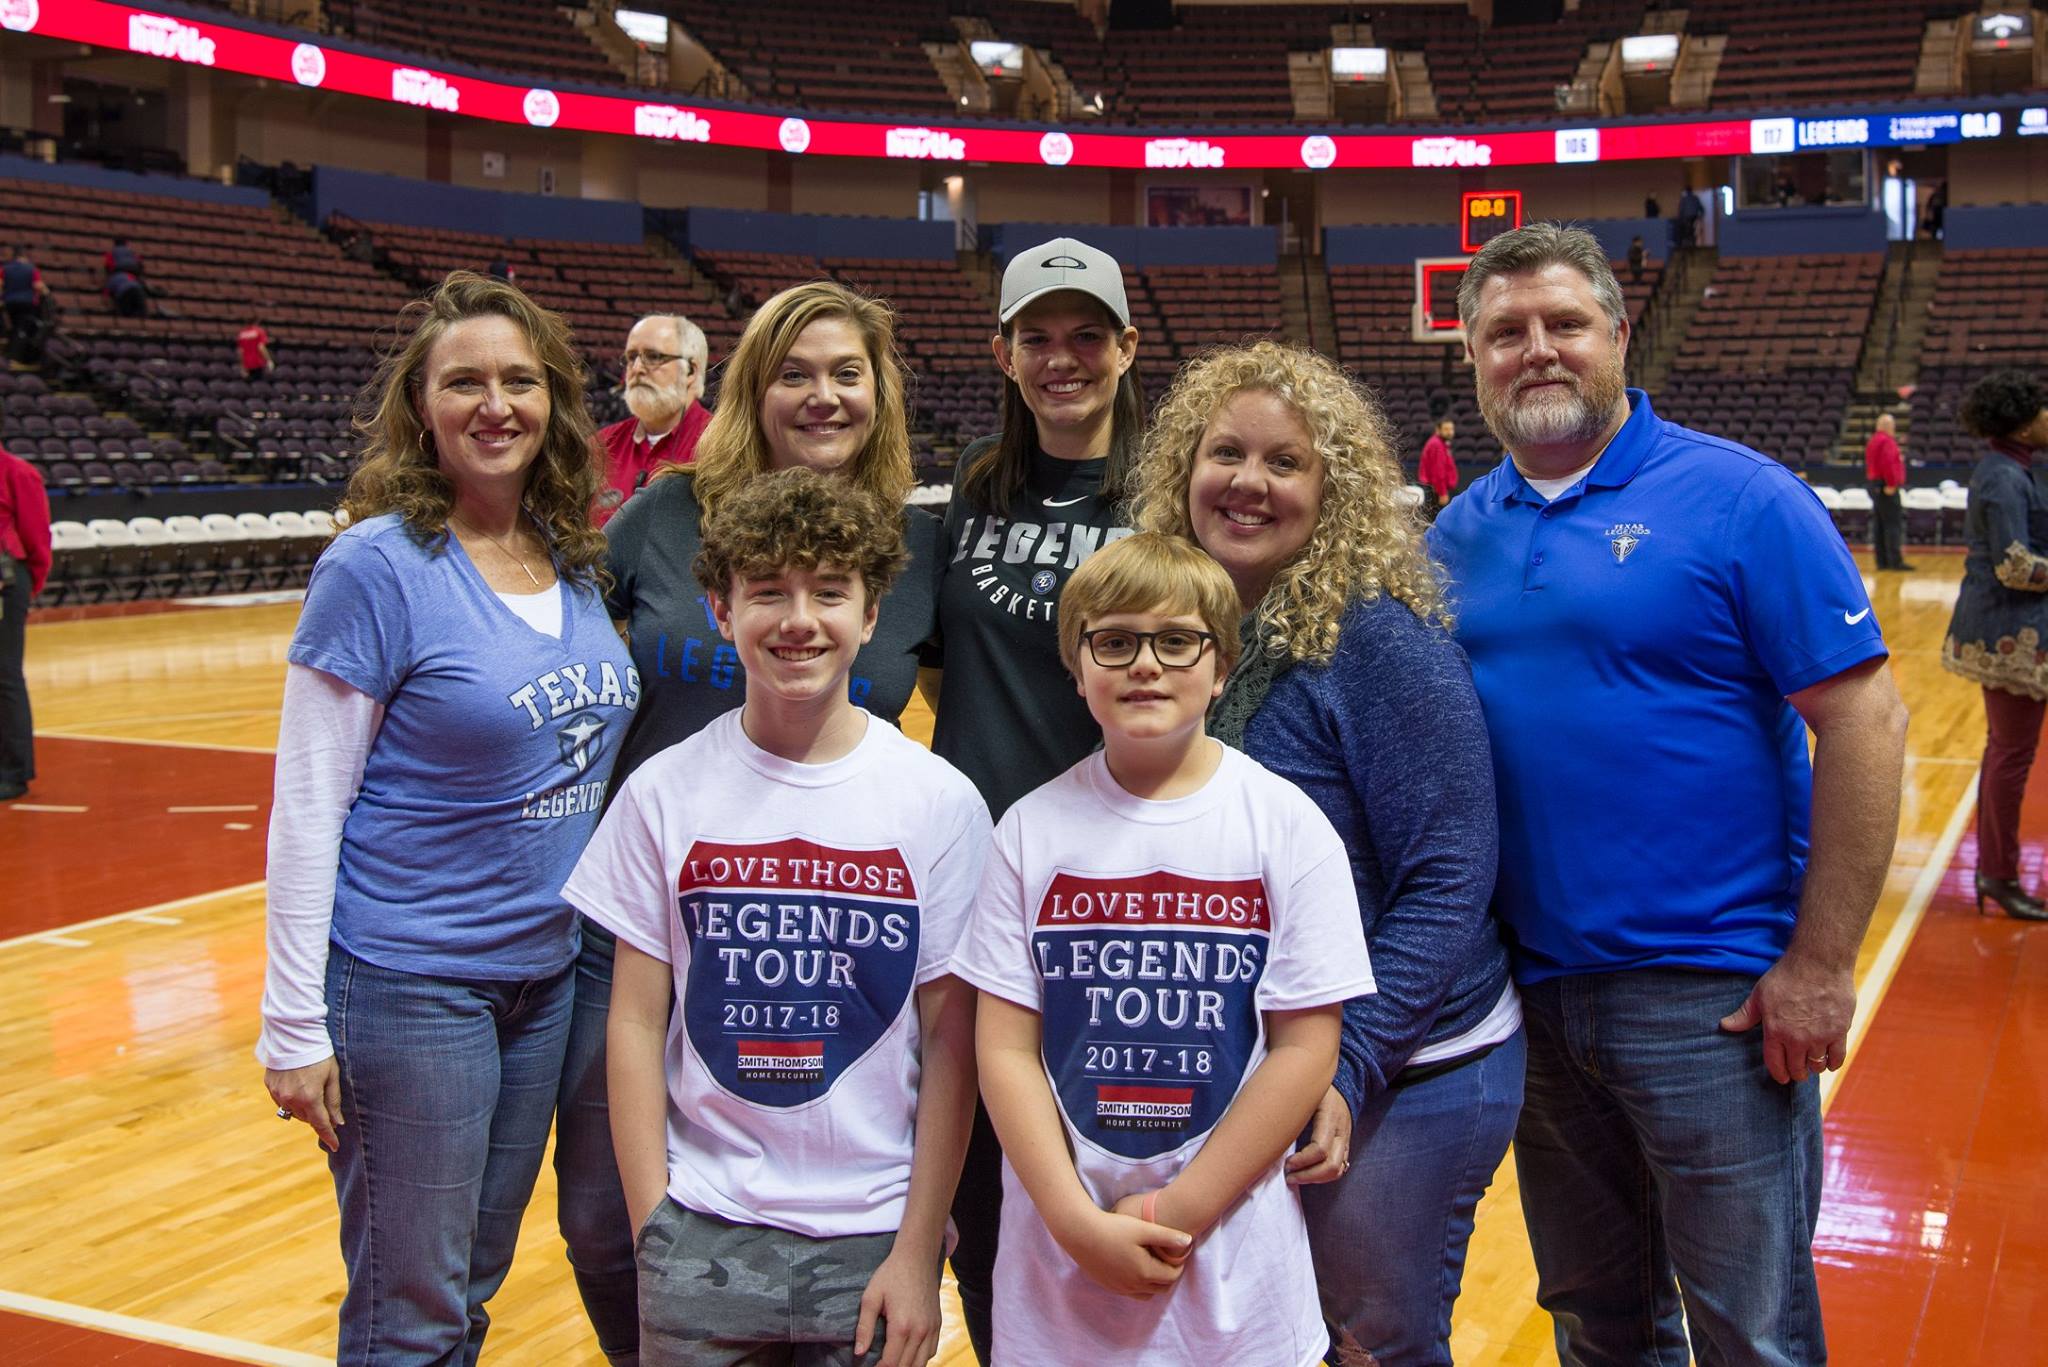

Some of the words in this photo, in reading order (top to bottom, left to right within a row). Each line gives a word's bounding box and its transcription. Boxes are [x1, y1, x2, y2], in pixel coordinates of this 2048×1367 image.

[1799, 119, 1869, 145] LEGENDS
[507, 660, 641, 730] TEXAS
[520, 779, 608, 818] LEGENDS
[689, 857, 781, 883] LOVE
[788, 858, 905, 893] THOSE
[1051, 892, 1144, 919] LOVE
[1152, 893, 1264, 923] THOSE
[689, 902, 910, 951] LEGENDS
[718, 948, 857, 989] TOUR
[1037, 939, 1259, 983] LEGENDS
[723, 1003, 842, 1029] 2017-18
[1086, 986, 1225, 1030] TOUR
[738, 1056, 769, 1067] SMITH
[772, 1056, 824, 1068] THOMPSON
[746, 1071, 771, 1079] HOME
[776, 1071, 820, 1079] SECURITY
[1084, 1046, 1212, 1074] 2017-18
[1097, 1102, 1130, 1114] SMITH
[1133, 1102, 1191, 1116] THOMPSON
[1106, 1118, 1132, 1128] HOME
[1136, 1119, 1183, 1128] SECURITY
